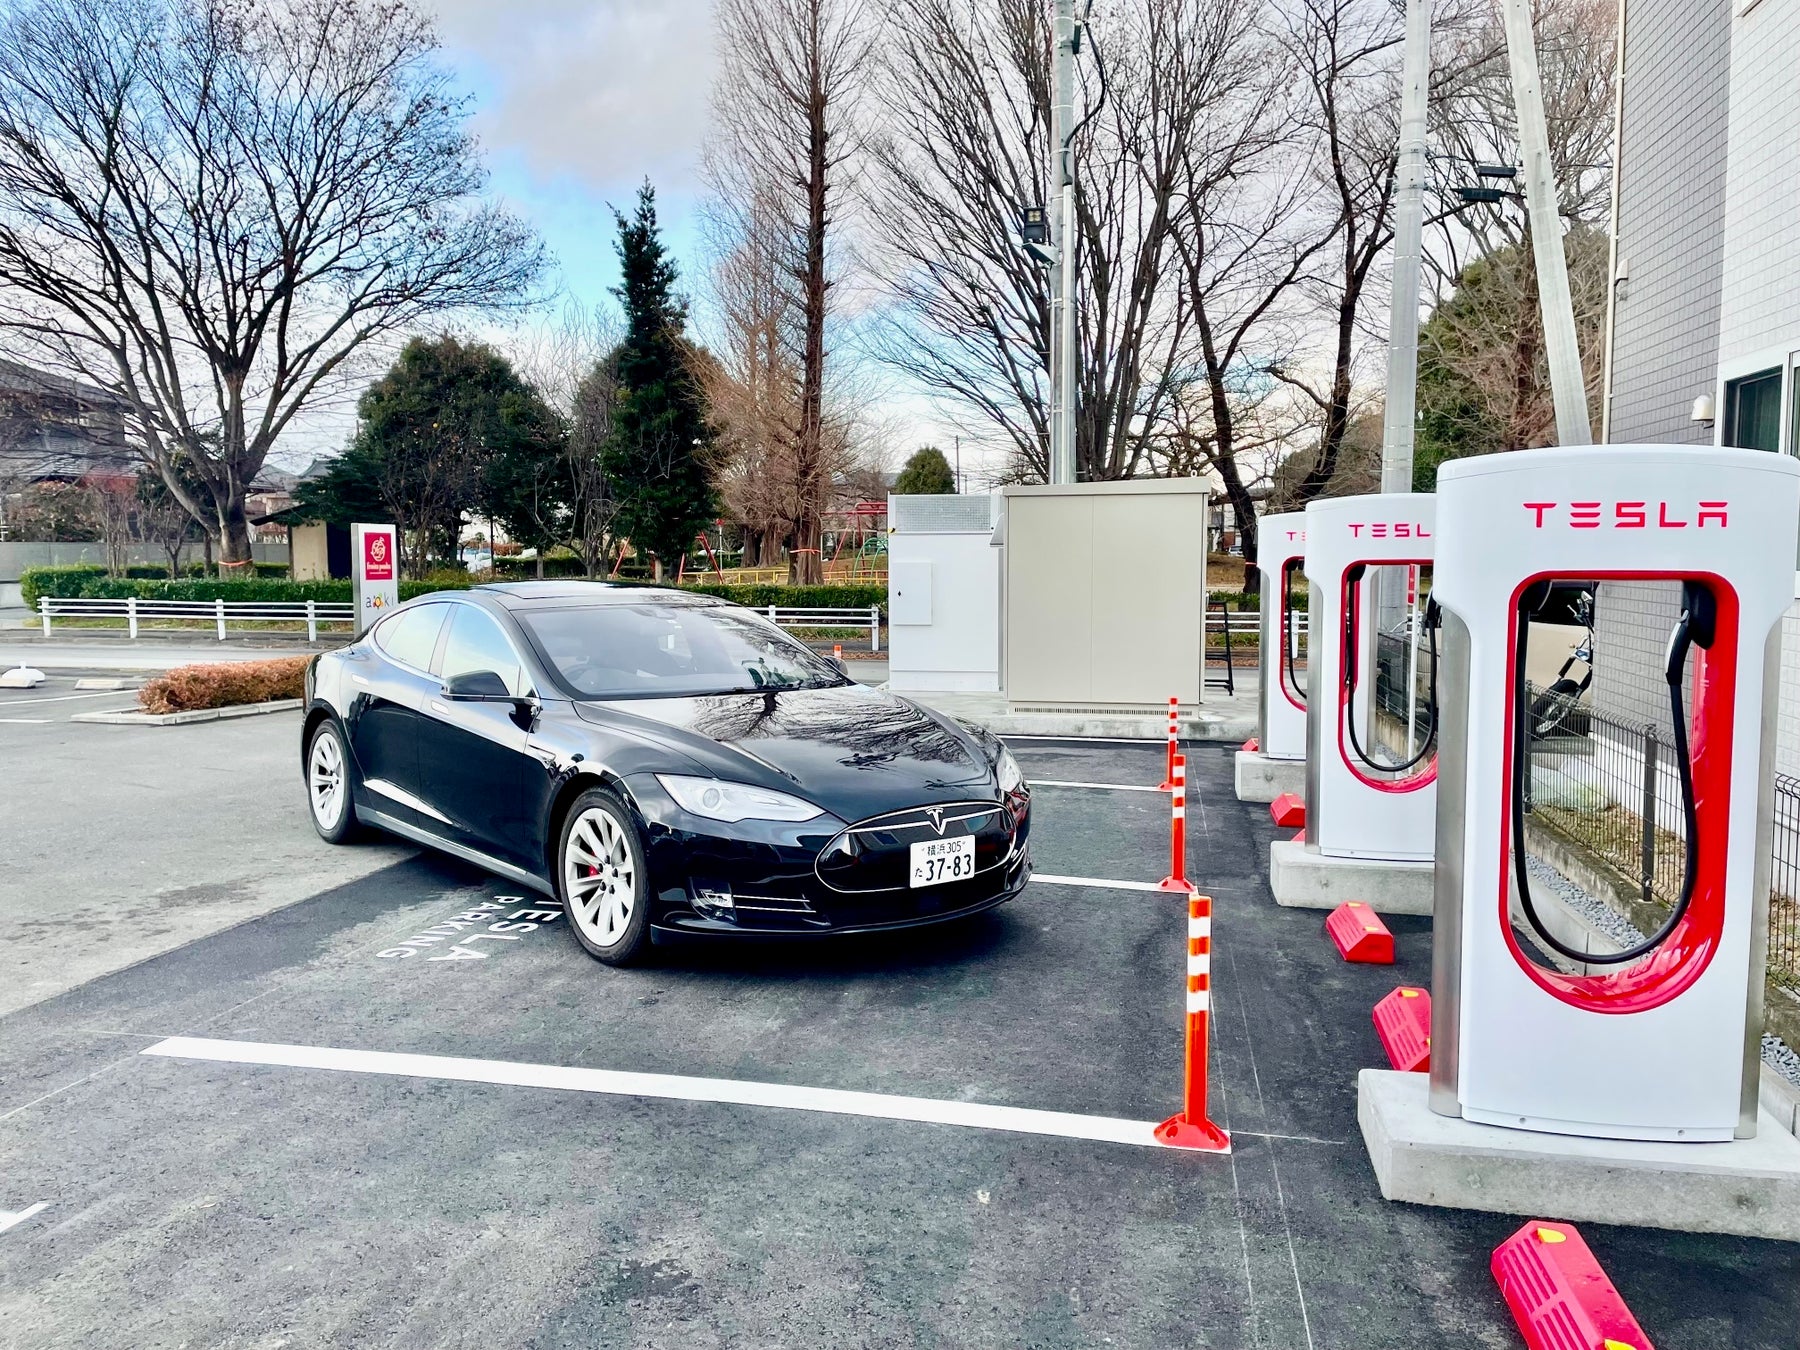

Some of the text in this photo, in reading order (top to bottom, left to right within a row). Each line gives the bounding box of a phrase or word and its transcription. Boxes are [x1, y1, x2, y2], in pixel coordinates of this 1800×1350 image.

[1523, 501, 1728, 528] TESLA
[1347, 522, 1432, 538] TESL
[926, 854, 972, 881] 37-83
[375, 895, 524, 959] PARKING
